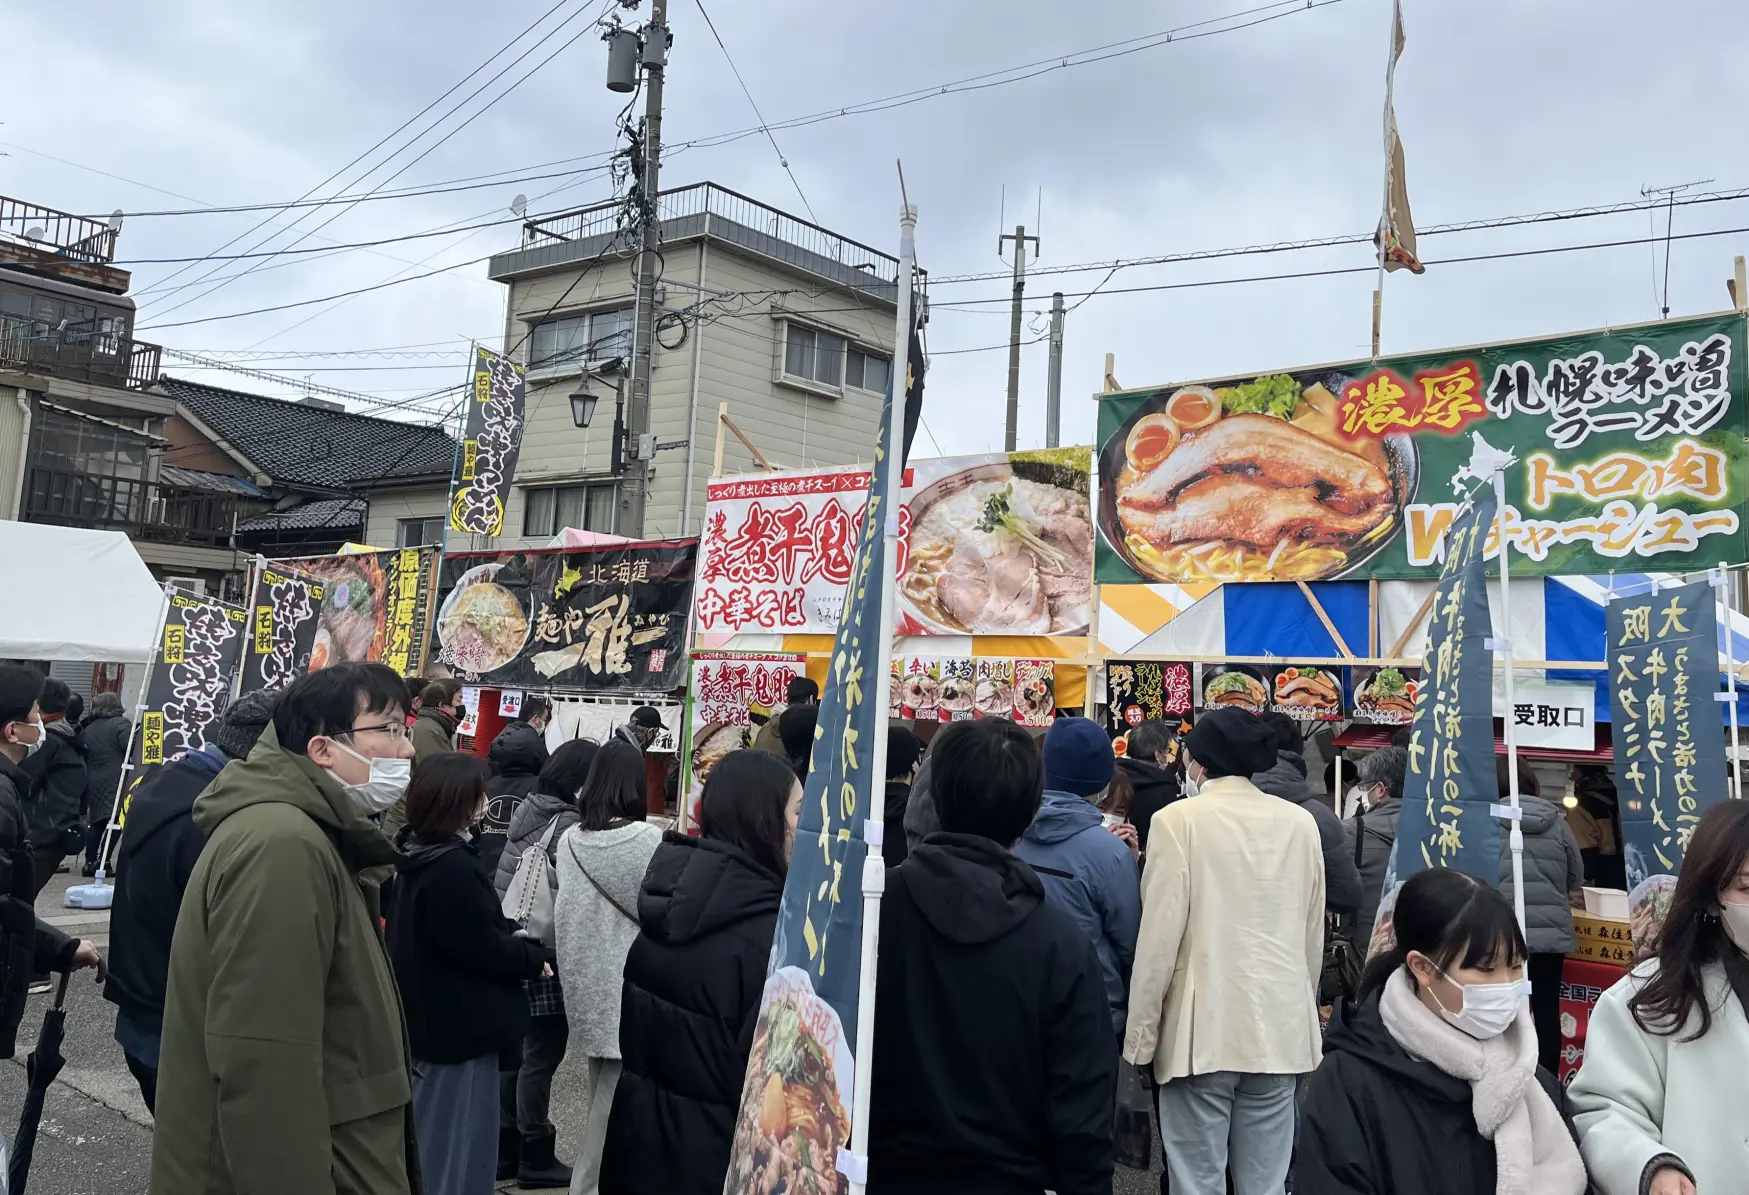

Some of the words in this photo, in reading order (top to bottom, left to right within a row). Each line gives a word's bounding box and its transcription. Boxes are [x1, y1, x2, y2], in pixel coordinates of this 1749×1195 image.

[477, 374, 490, 400] 石狩
[1343, 367, 1483, 435] 濃厚
[1485, 335, 1732, 419] 札幌味噌
[1547, 392, 1732, 448] ラーメン
[463, 443, 477, 478] 麺や雅
[1527, 441, 1729, 508] トロ肉
[708, 476, 904, 499] じっくり煮出した至極の煮干スープ×コク
[702, 510, 729, 582] 濃厚
[725, 497, 912, 585] 煮干鬼
[588, 559, 651, 586] 北海道
[387, 549, 419, 678] 原価度外視
[634, 613, 670, 627] みやび
[697, 586, 806, 633] 中華そば
[167, 629, 182, 660] 石狩
[258, 610, 271, 649] 石狩
[531, 594, 634, 678] 麺や雅
[698, 665, 713, 702] 濃厚
[909, 657, 936, 675] 辛い
[945, 659, 973, 679] 海苔
[978, 660, 1012, 680] 肉増し
[1016, 661, 1054, 681] デラックス
[1135, 663, 1148, 704] ラーメン
[502, 695, 520, 706] 受渡口
[1165, 664, 1191, 714] 濃厚
[701, 704, 751, 726] 中華そば
[1514, 704, 1584, 727] 受取口
[145, 716, 161, 760] 麺や雅
[1559, 985, 1603, 1003] 全国ラ
